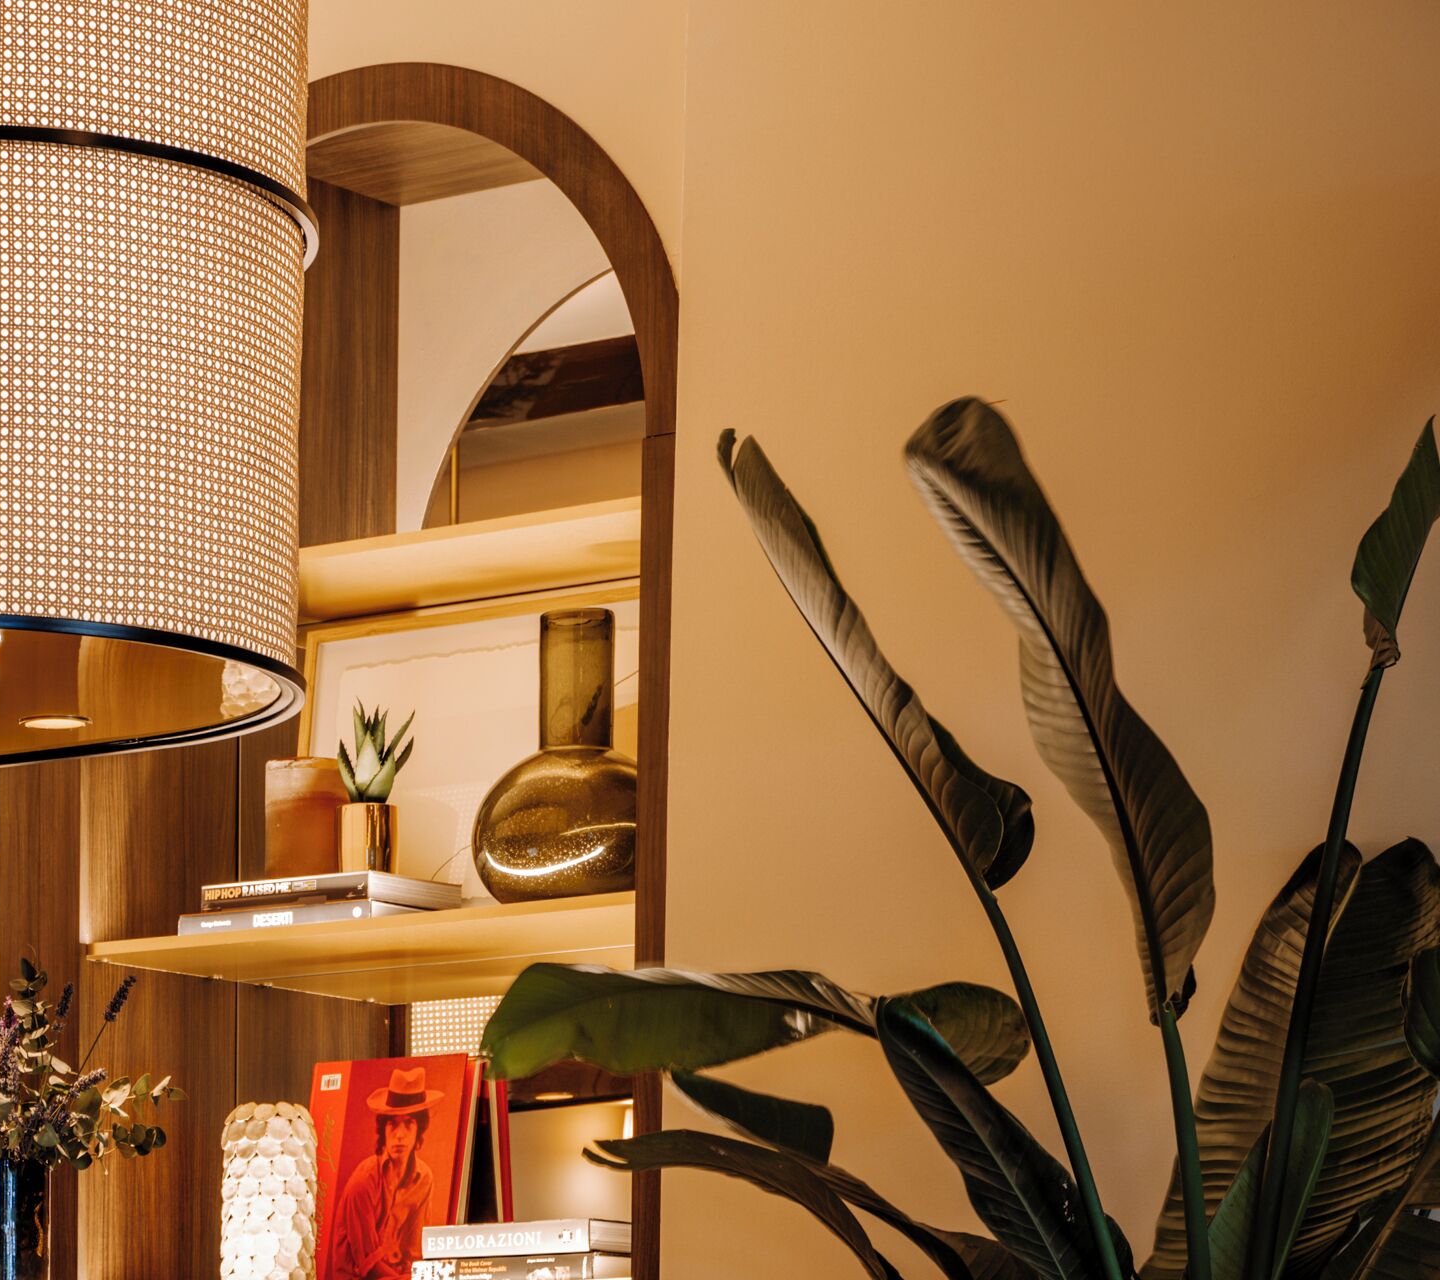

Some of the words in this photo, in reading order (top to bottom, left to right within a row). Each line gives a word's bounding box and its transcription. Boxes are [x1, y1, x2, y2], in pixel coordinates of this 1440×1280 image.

[205, 888, 221, 901] HIP
[221, 887, 241, 899] HOP
[242, 883, 275, 897] RAISED
[427, 1231, 542, 1251] ESPLORAZIONI
